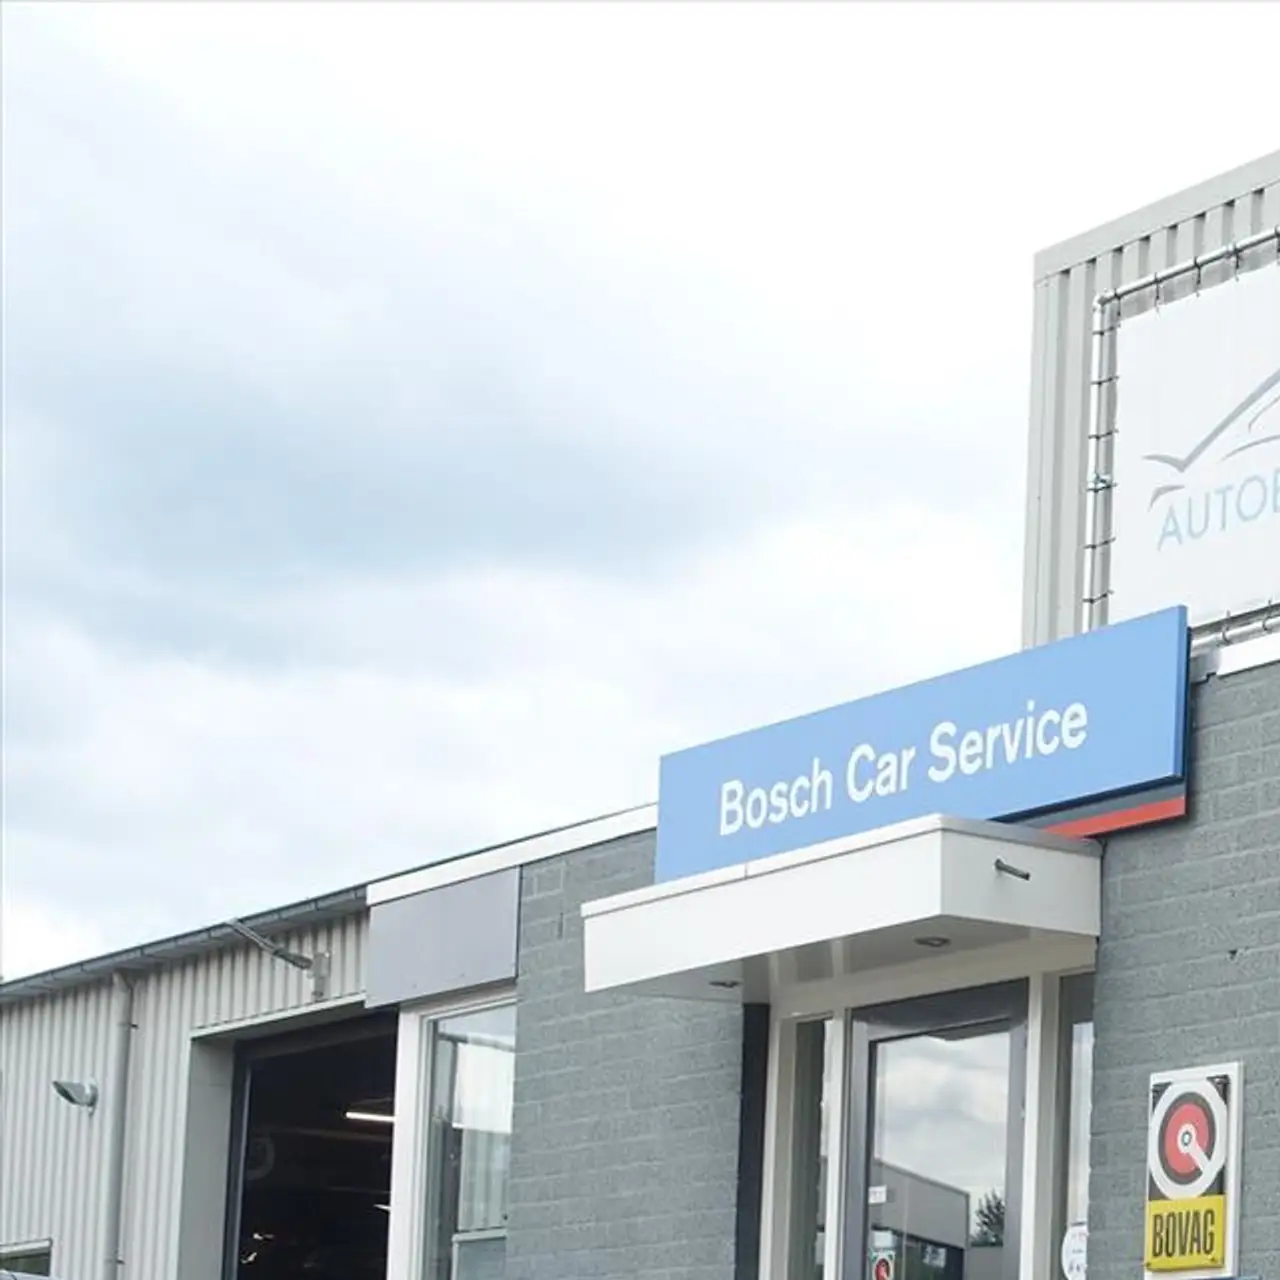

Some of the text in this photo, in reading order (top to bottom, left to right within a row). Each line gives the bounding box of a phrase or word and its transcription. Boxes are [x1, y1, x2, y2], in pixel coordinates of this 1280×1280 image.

[720, 700, 1088, 836] Bosch Car Service
[1152, 1209, 1215, 1258] BOVAG
